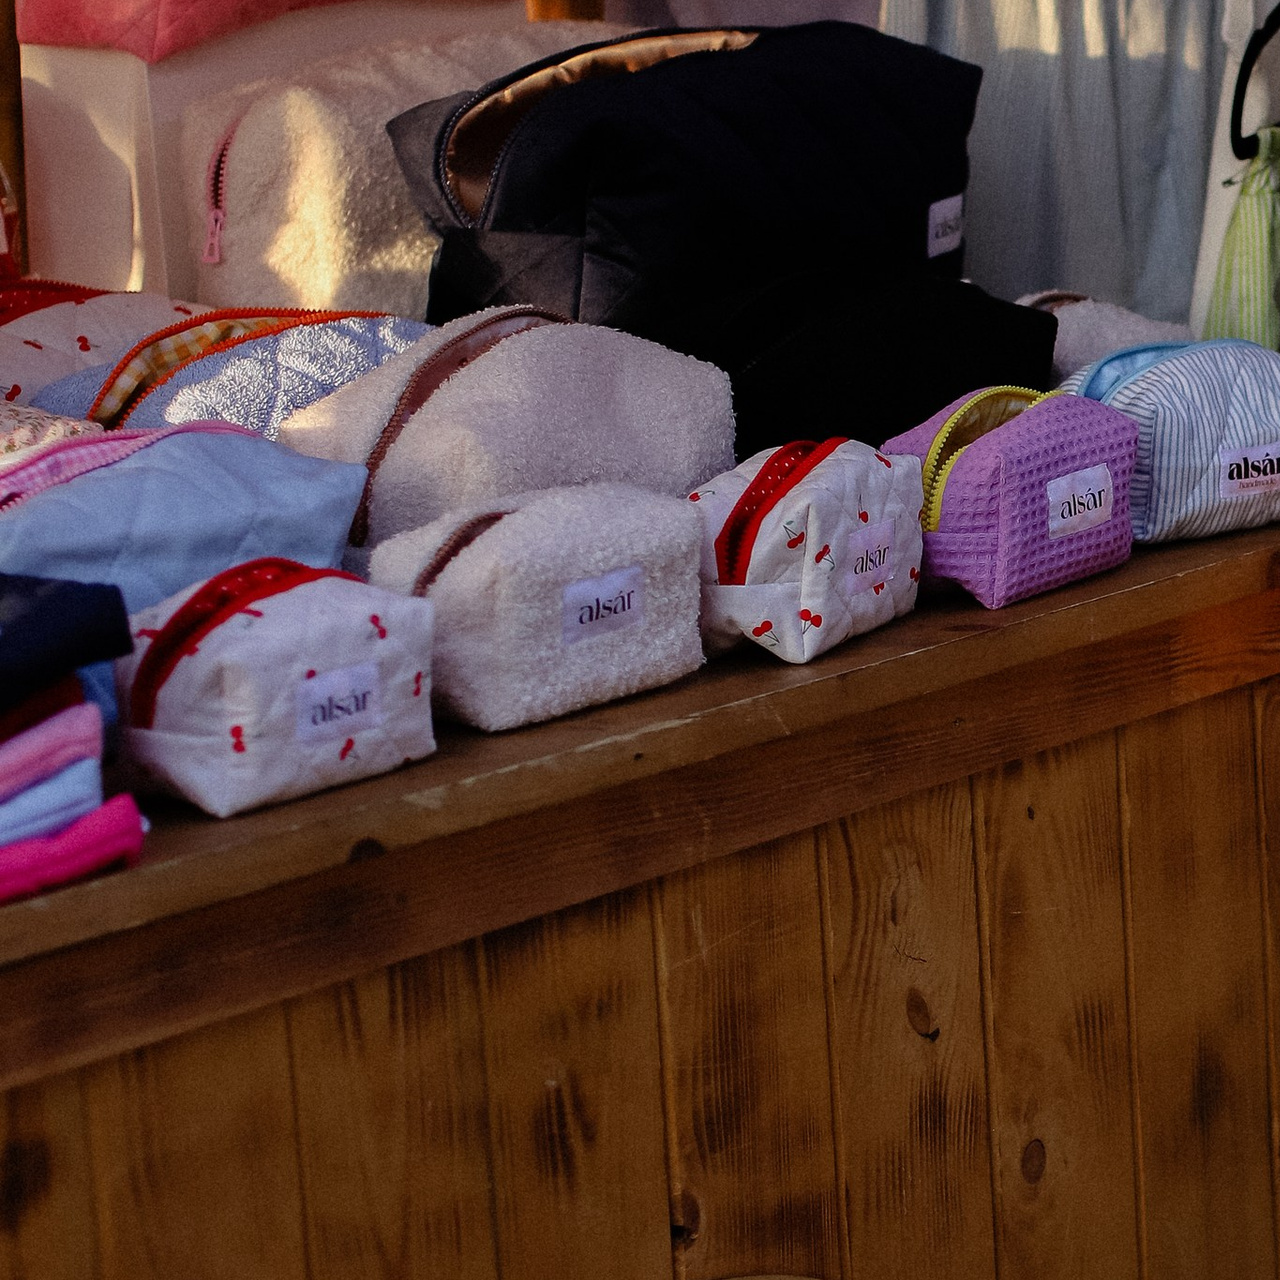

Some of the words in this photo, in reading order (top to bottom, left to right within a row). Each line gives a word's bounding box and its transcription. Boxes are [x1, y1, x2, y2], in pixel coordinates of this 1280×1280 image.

[1060, 487, 1105, 519] alsár
[854, 544, 889, 575] alsár
[579, 589, 634, 624] alsár
